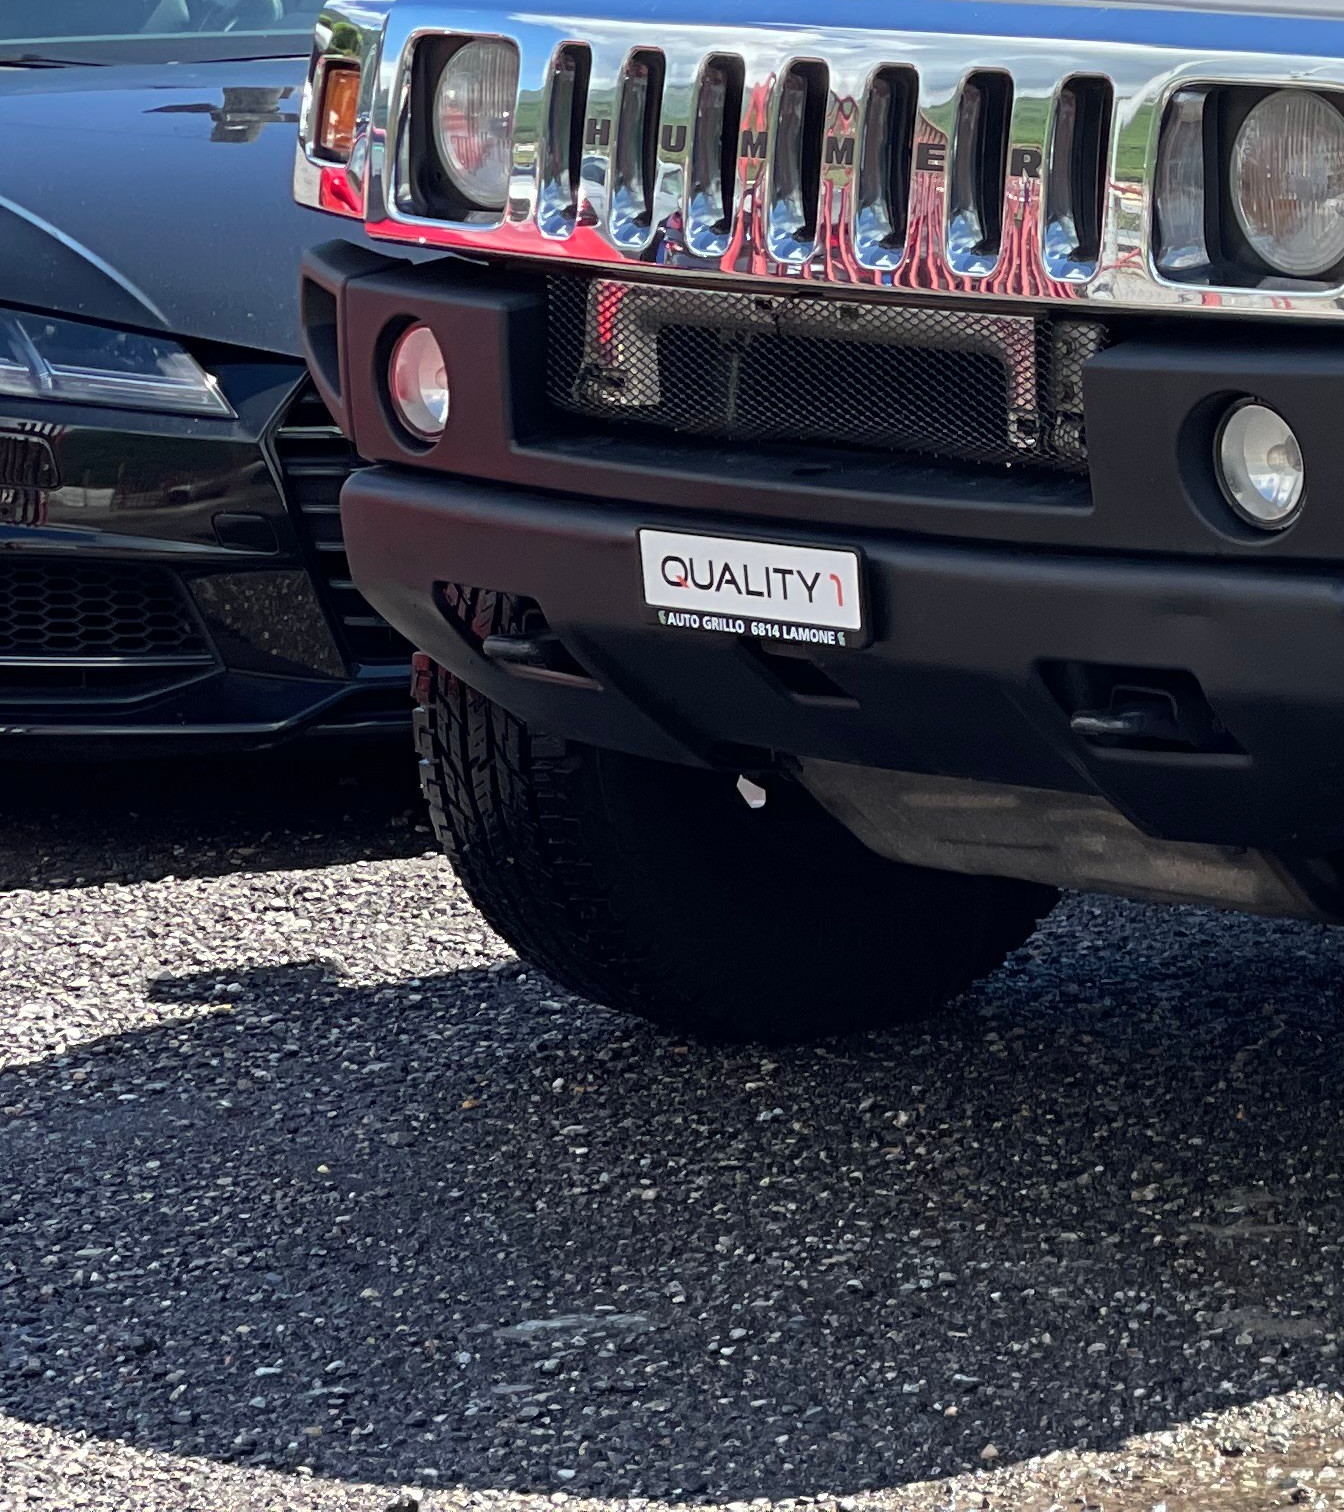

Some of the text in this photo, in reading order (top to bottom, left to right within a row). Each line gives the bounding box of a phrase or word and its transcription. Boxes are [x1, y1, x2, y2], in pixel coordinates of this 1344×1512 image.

[584, 117, 1043, 178] HUMMER
[661, 554, 844, 607] QUALITY 1
[667, 611, 836, 645] AUTO GRILLO 6814 LAMONE
